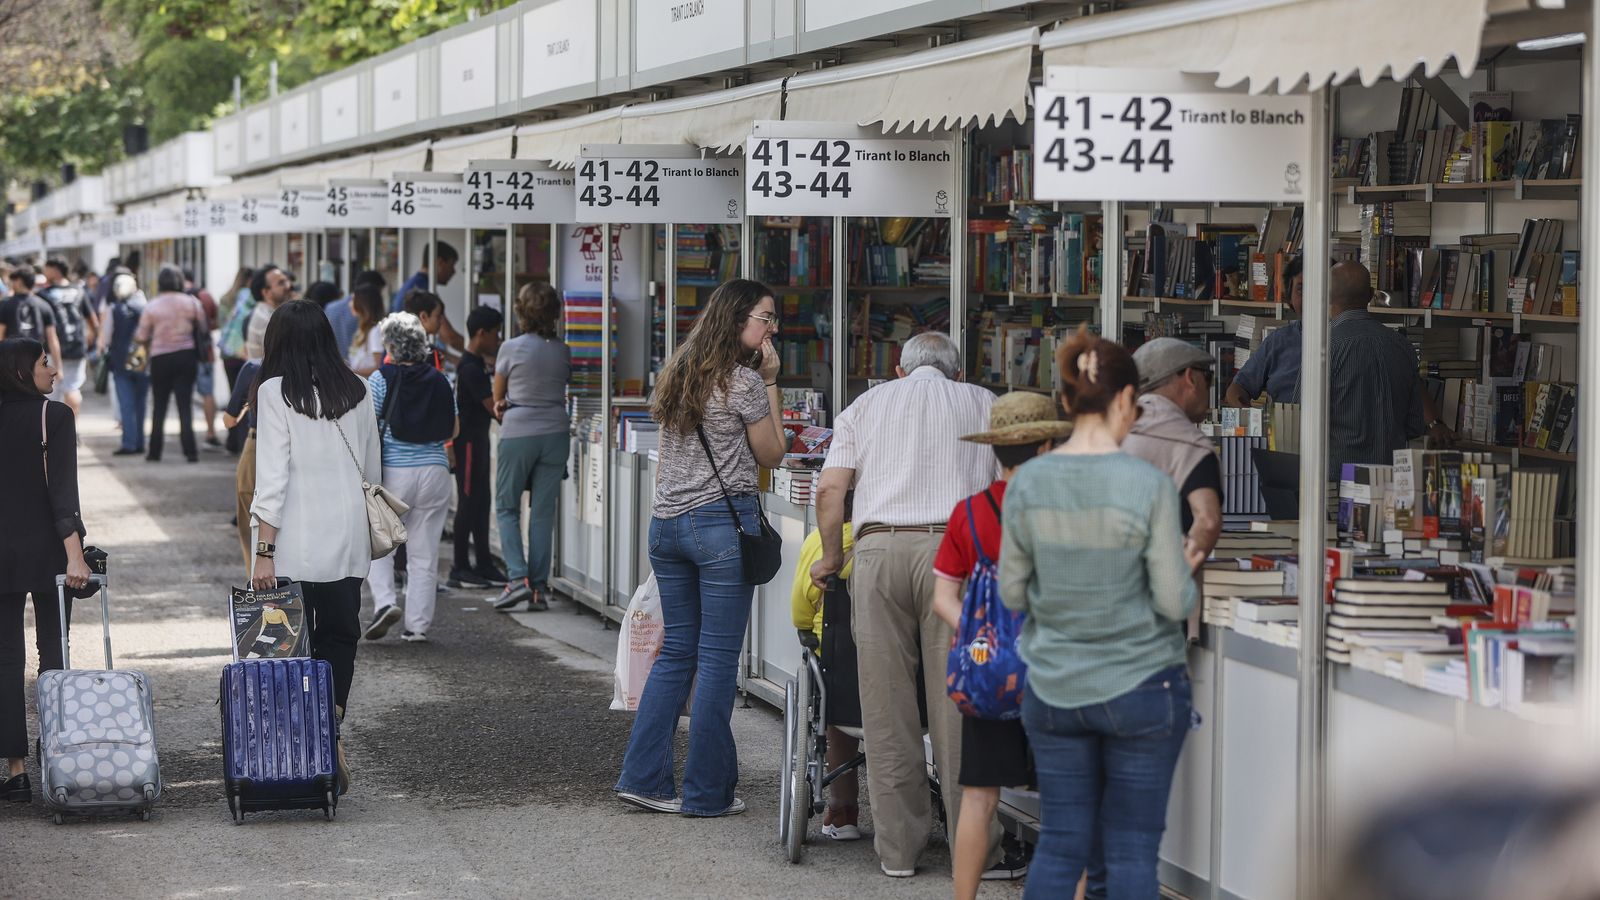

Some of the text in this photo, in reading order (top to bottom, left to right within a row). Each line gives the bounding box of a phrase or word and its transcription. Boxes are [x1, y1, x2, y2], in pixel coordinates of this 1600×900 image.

[1043, 96, 1304, 131] 41-42 Tirant lo Blanch
[752, 140, 950, 167] 41-42 Tirant lo Blanch
[1043, 138, 1174, 172] 43-44
[579, 160, 659, 182] 41-42
[662, 167, 692, 177] Tirant
[693, 167, 704, 177] lo
[705, 167, 739, 177] Blanch
[467, 171, 534, 190] 41-42
[536, 177, 561, 186] Tirant
[562, 177, 571, 186] lo
[752, 171, 852, 198] 43-44
[281, 190, 299, 202] 47
[327, 187, 348, 201] 45
[391, 181, 462, 198] 45 Libro Ideas
[579, 185, 660, 207] 43-44
[391, 200, 415, 215] 46
[467, 192, 535, 210] 43-44
[281, 205, 299, 218] 48
[327, 203, 348, 217] 46
[585, 263, 619, 274] tirat
[234, 591, 256, 604] 58
